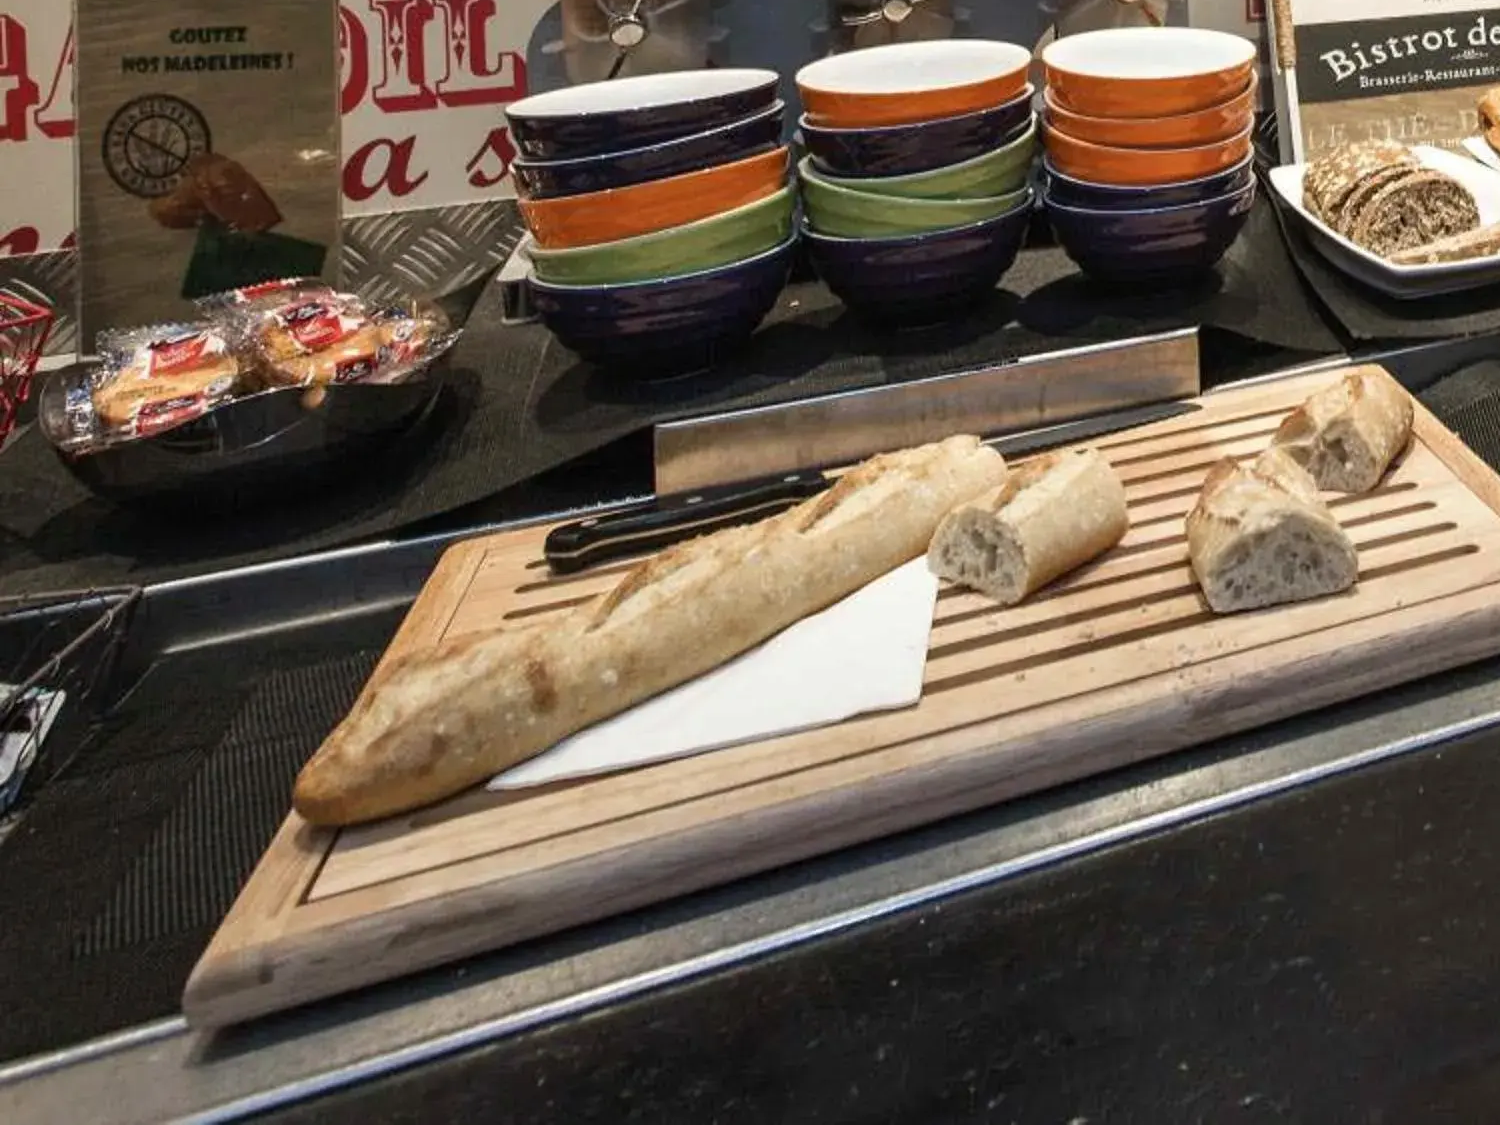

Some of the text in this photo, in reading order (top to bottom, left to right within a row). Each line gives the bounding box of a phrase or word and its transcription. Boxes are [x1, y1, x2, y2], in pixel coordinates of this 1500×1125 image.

[169, 26, 248, 44] GOUTEZ
[1320, 26, 1458, 83] Bistrot
[121, 55, 160, 74] NOS
[164, 53, 284, 73] MADELEINES
[341, 138, 428, 201] a
